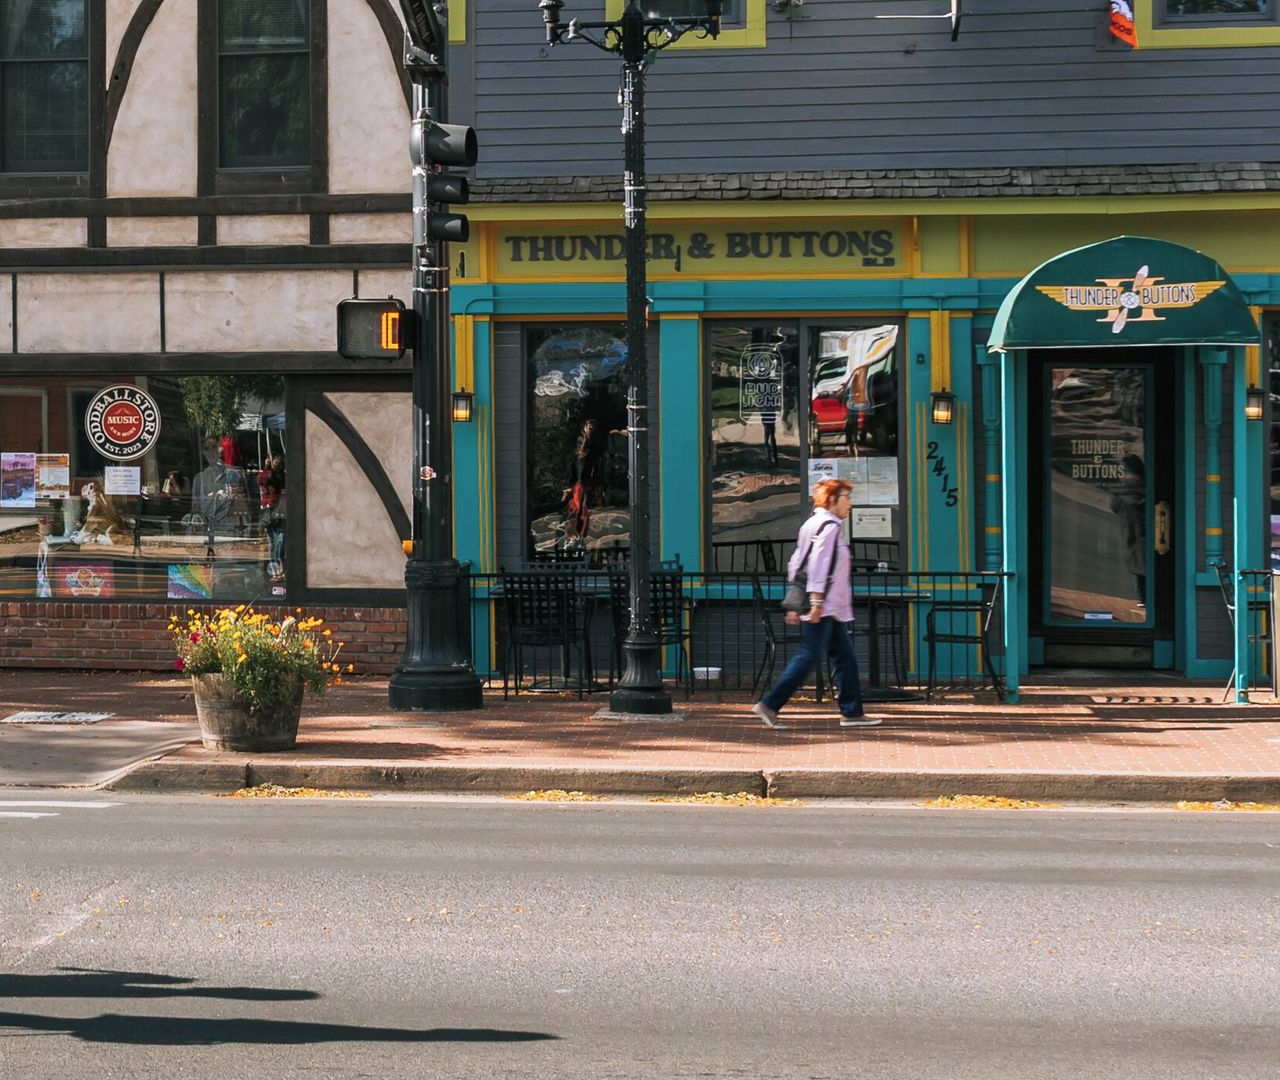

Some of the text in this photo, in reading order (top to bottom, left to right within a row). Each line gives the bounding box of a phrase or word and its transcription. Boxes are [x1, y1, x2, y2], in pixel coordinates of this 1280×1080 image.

[505, 229, 894, 262] THUNDR & BUTTONS
[1063, 288, 1118, 306] THUNDER
[1142, 284, 1196, 305] BUTTONS
[744, 382, 780, 395] BUD
[107, 415, 140, 424] MUSIC
[105, 442, 122, 454] EST.
[1070, 439, 1125, 454] THUNDER
[1093, 455, 1103, 463] &
[926, 441, 959, 507] 2415
[1071, 464, 1125, 478] BUTTONS
